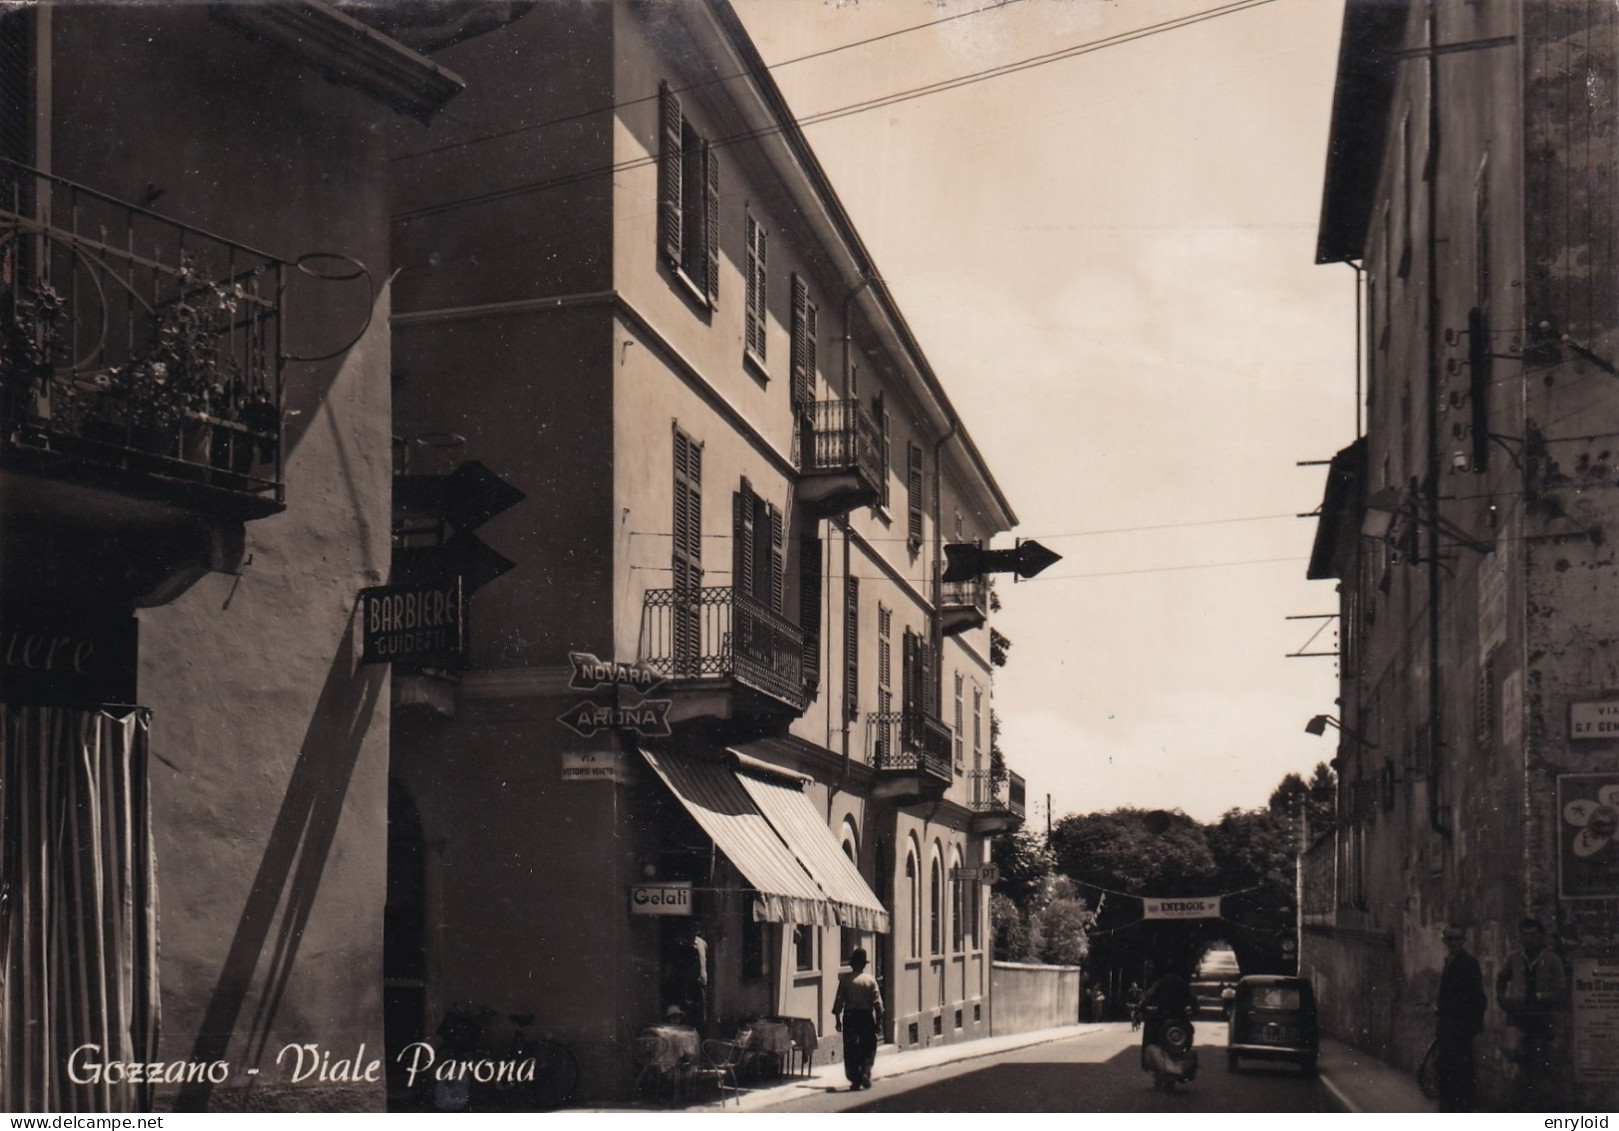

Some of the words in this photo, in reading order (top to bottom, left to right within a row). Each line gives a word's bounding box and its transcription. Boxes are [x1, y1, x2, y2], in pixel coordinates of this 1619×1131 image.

[370, 588, 457, 633] BARBIERE
[582, 664, 653, 684] NOVARA
[577, 710, 658, 726] ARONA
[1598, 706, 1619, 715] VIA
[983, 868, 996, 880] PT
[634, 888, 687, 905] Gelati
